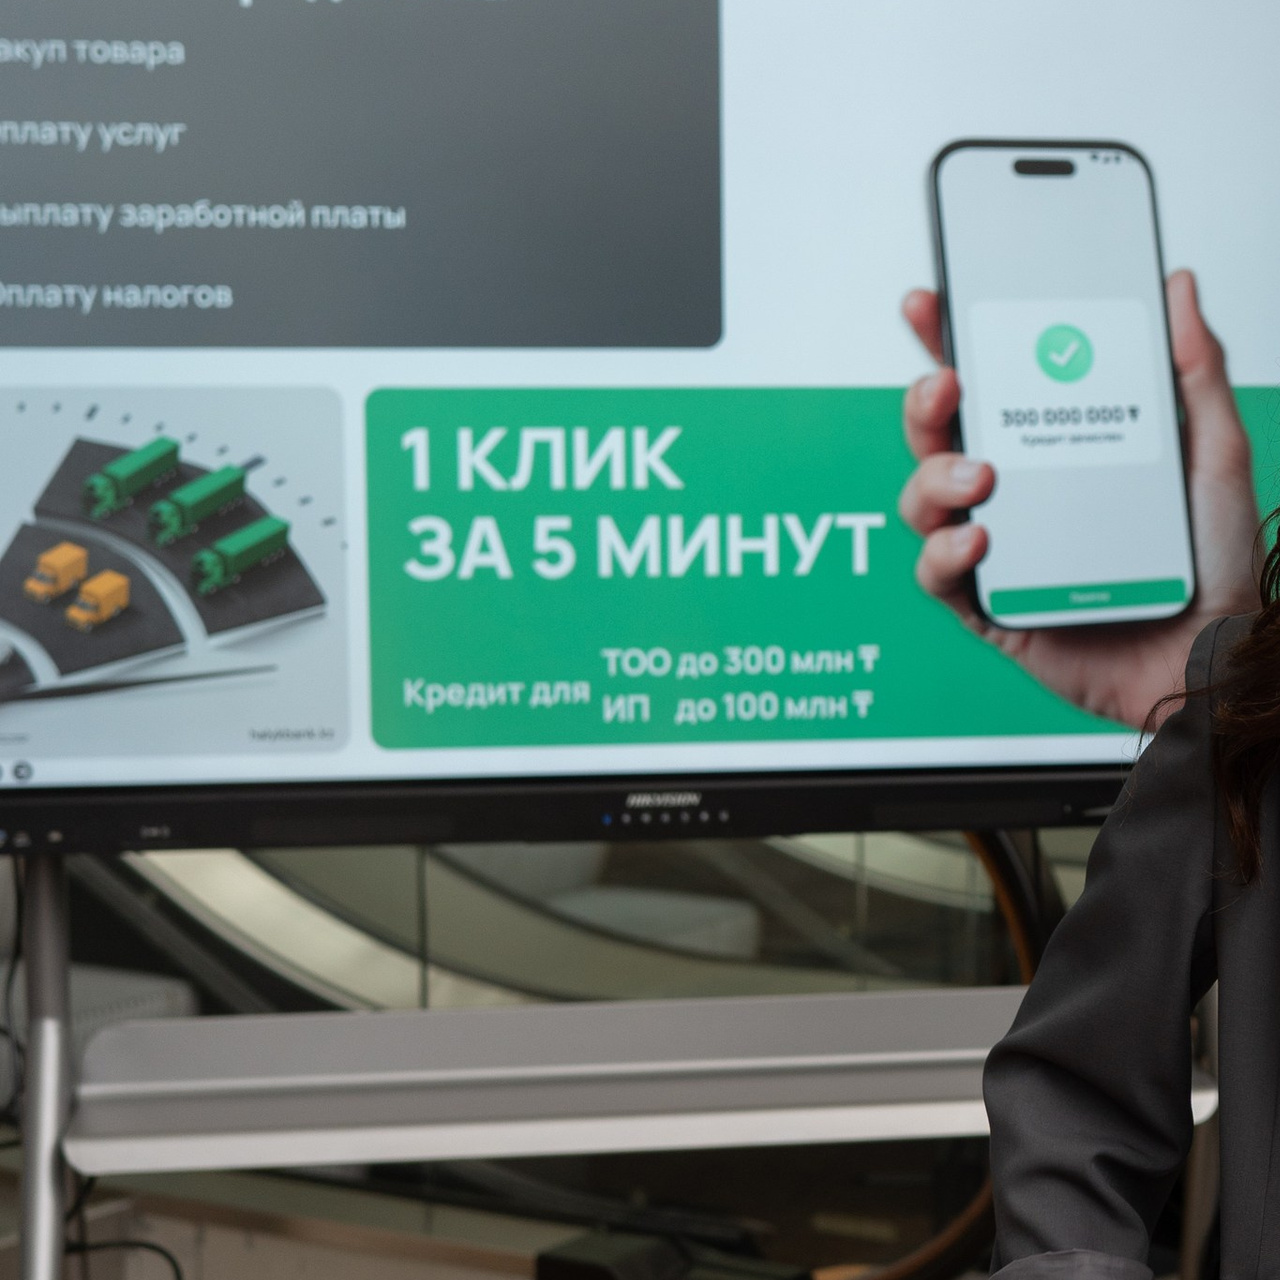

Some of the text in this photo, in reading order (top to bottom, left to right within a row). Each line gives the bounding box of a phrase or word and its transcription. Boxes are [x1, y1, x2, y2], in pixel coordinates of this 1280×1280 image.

[71, 39, 186, 71] товара
[97, 121, 187, 154] услуг
[118, 198, 306, 235] заработной
[310, 205, 406, 230] платы
[0, 282, 234, 315] плату налогов
[400, 425, 685, 492] 1 КЛИК
[403, 513, 887, 582] ЗА 5 МИНУТ
[602, 647, 671, 677] ТОО
[675, 650, 719, 680] до
[723, 646, 786, 676] 300
[790, 649, 855, 674] млн
[403, 678, 592, 714] Кредит для
[602, 694, 651, 724] ИП
[673, 695, 717, 726] до
[722, 691, 780, 721] 100
[785, 693, 848, 719] млн
